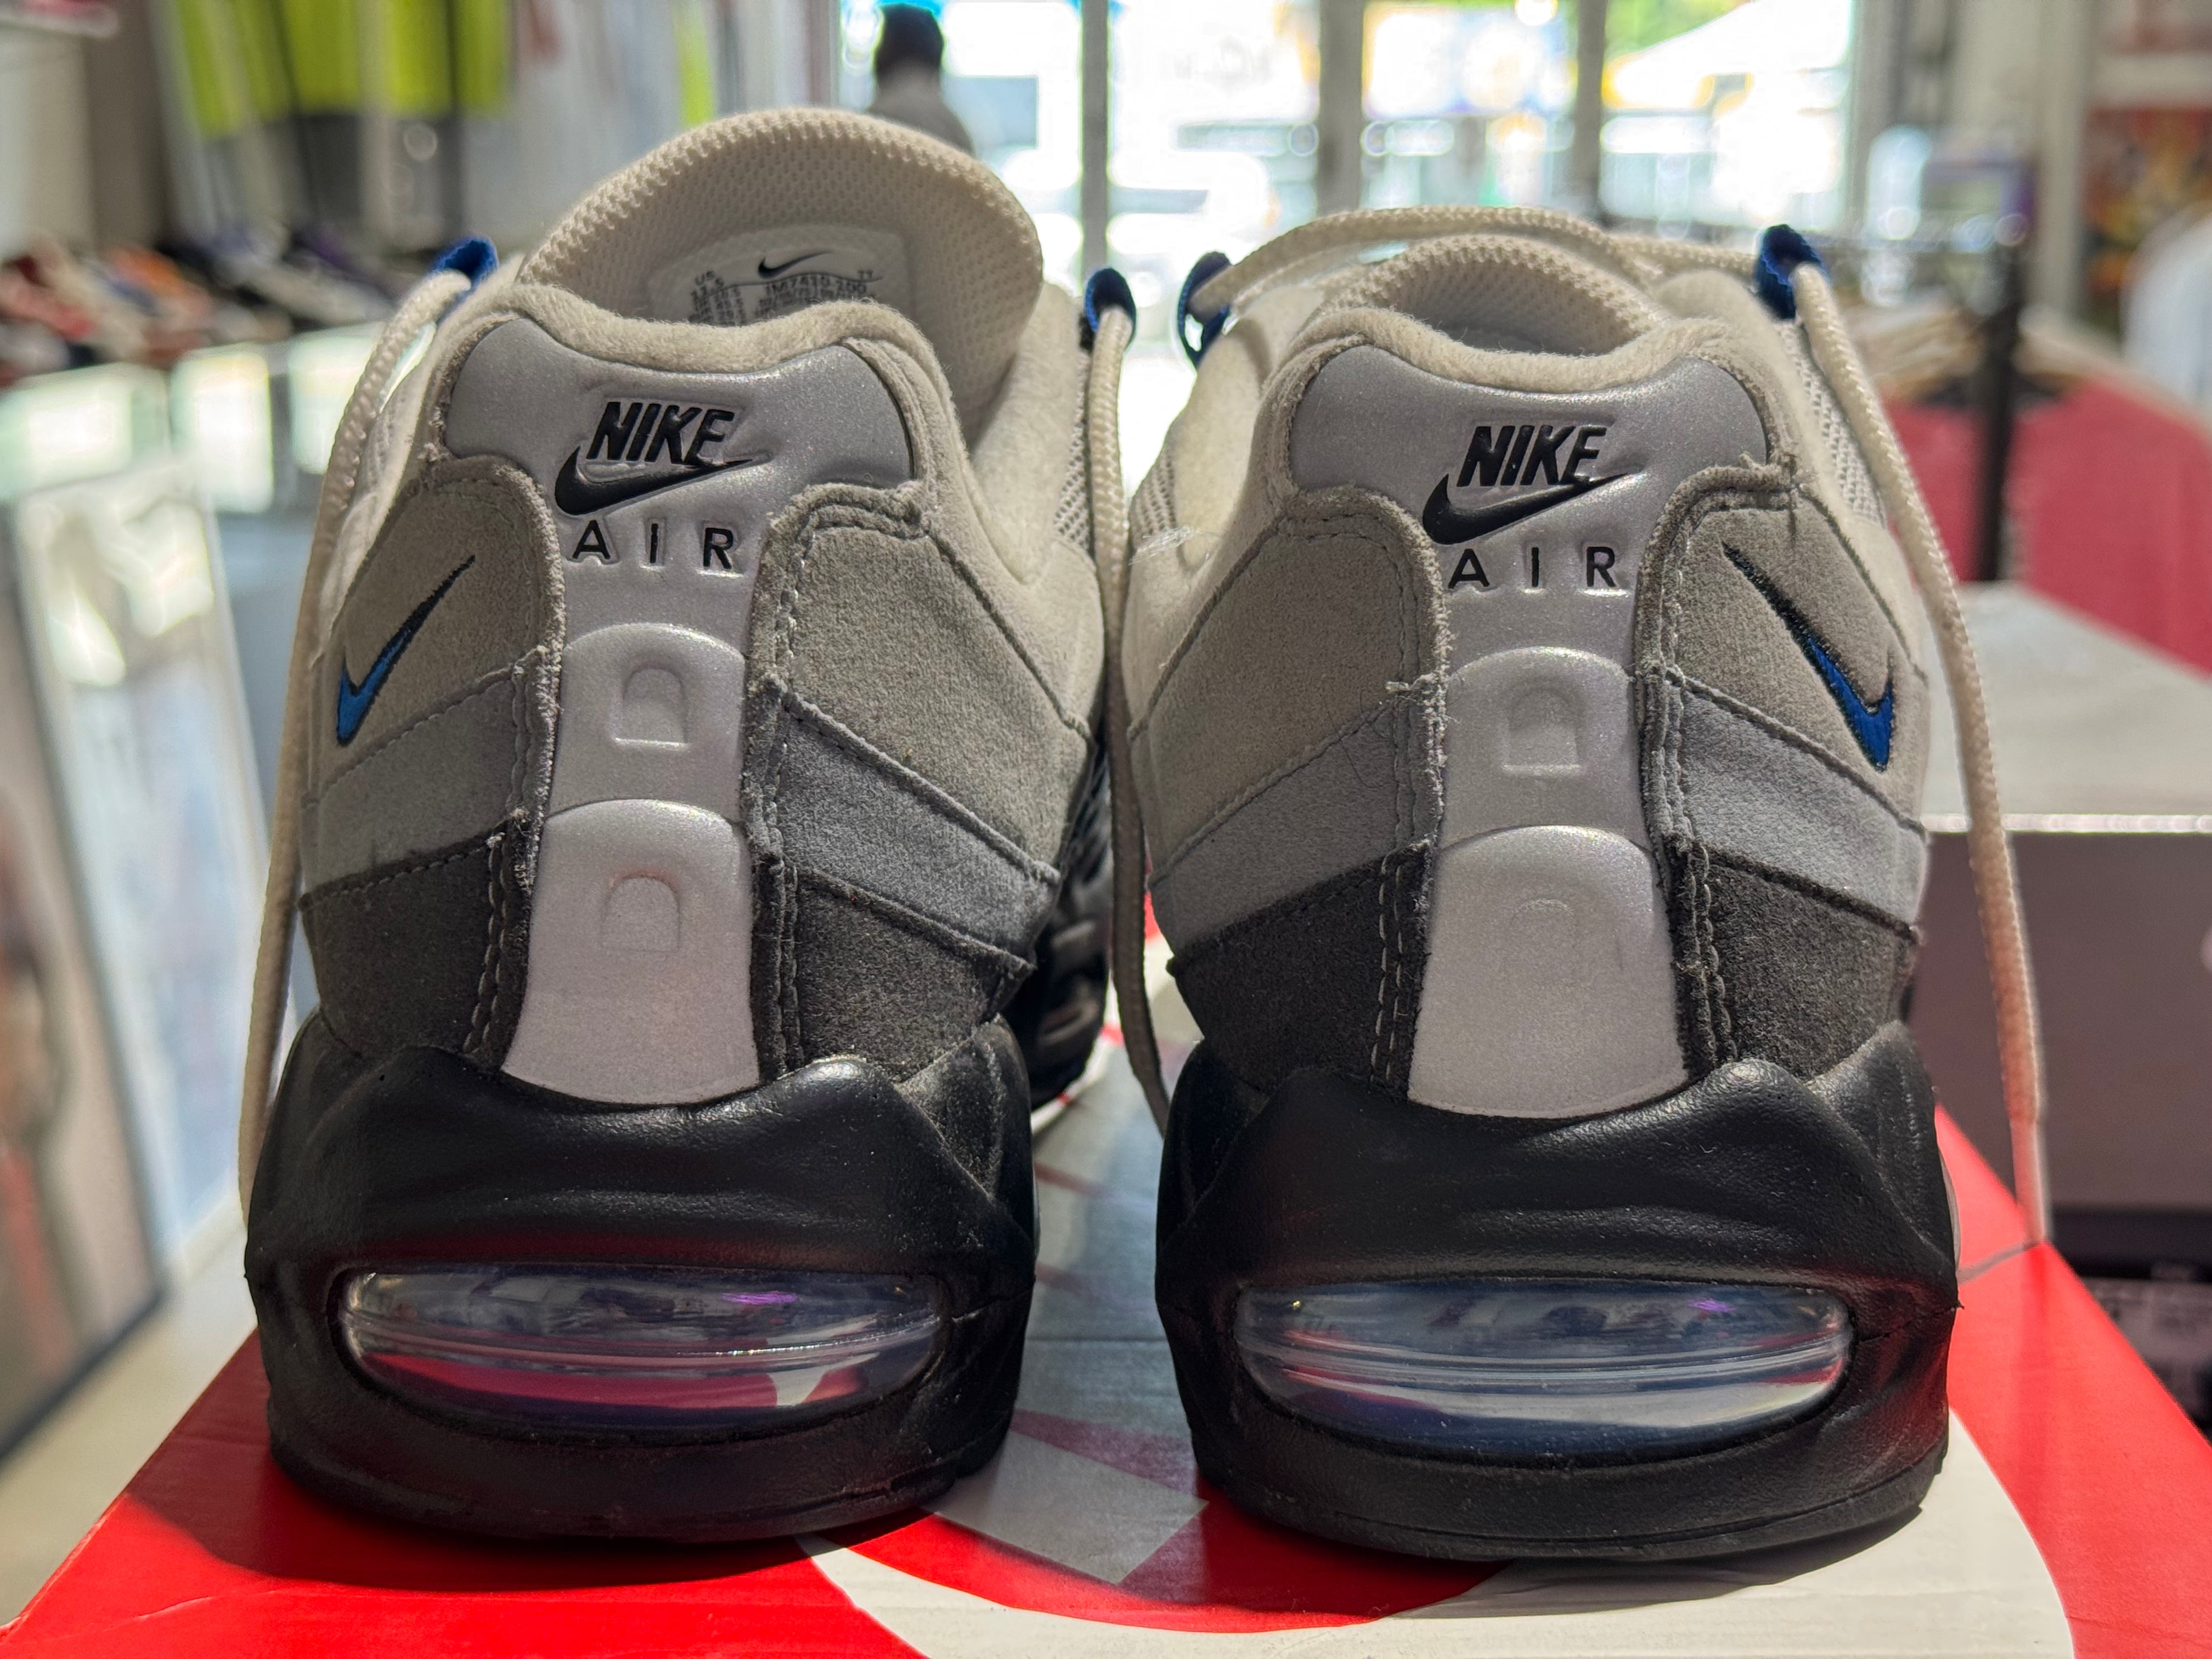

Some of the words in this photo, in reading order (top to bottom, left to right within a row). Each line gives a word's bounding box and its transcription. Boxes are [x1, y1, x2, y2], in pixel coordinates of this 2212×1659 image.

[586, 402, 735, 466] NIKE
[1457, 425, 1607, 487] NIKE
[572, 520, 734, 570] AIR
[1448, 546, 1616, 589] AIR
